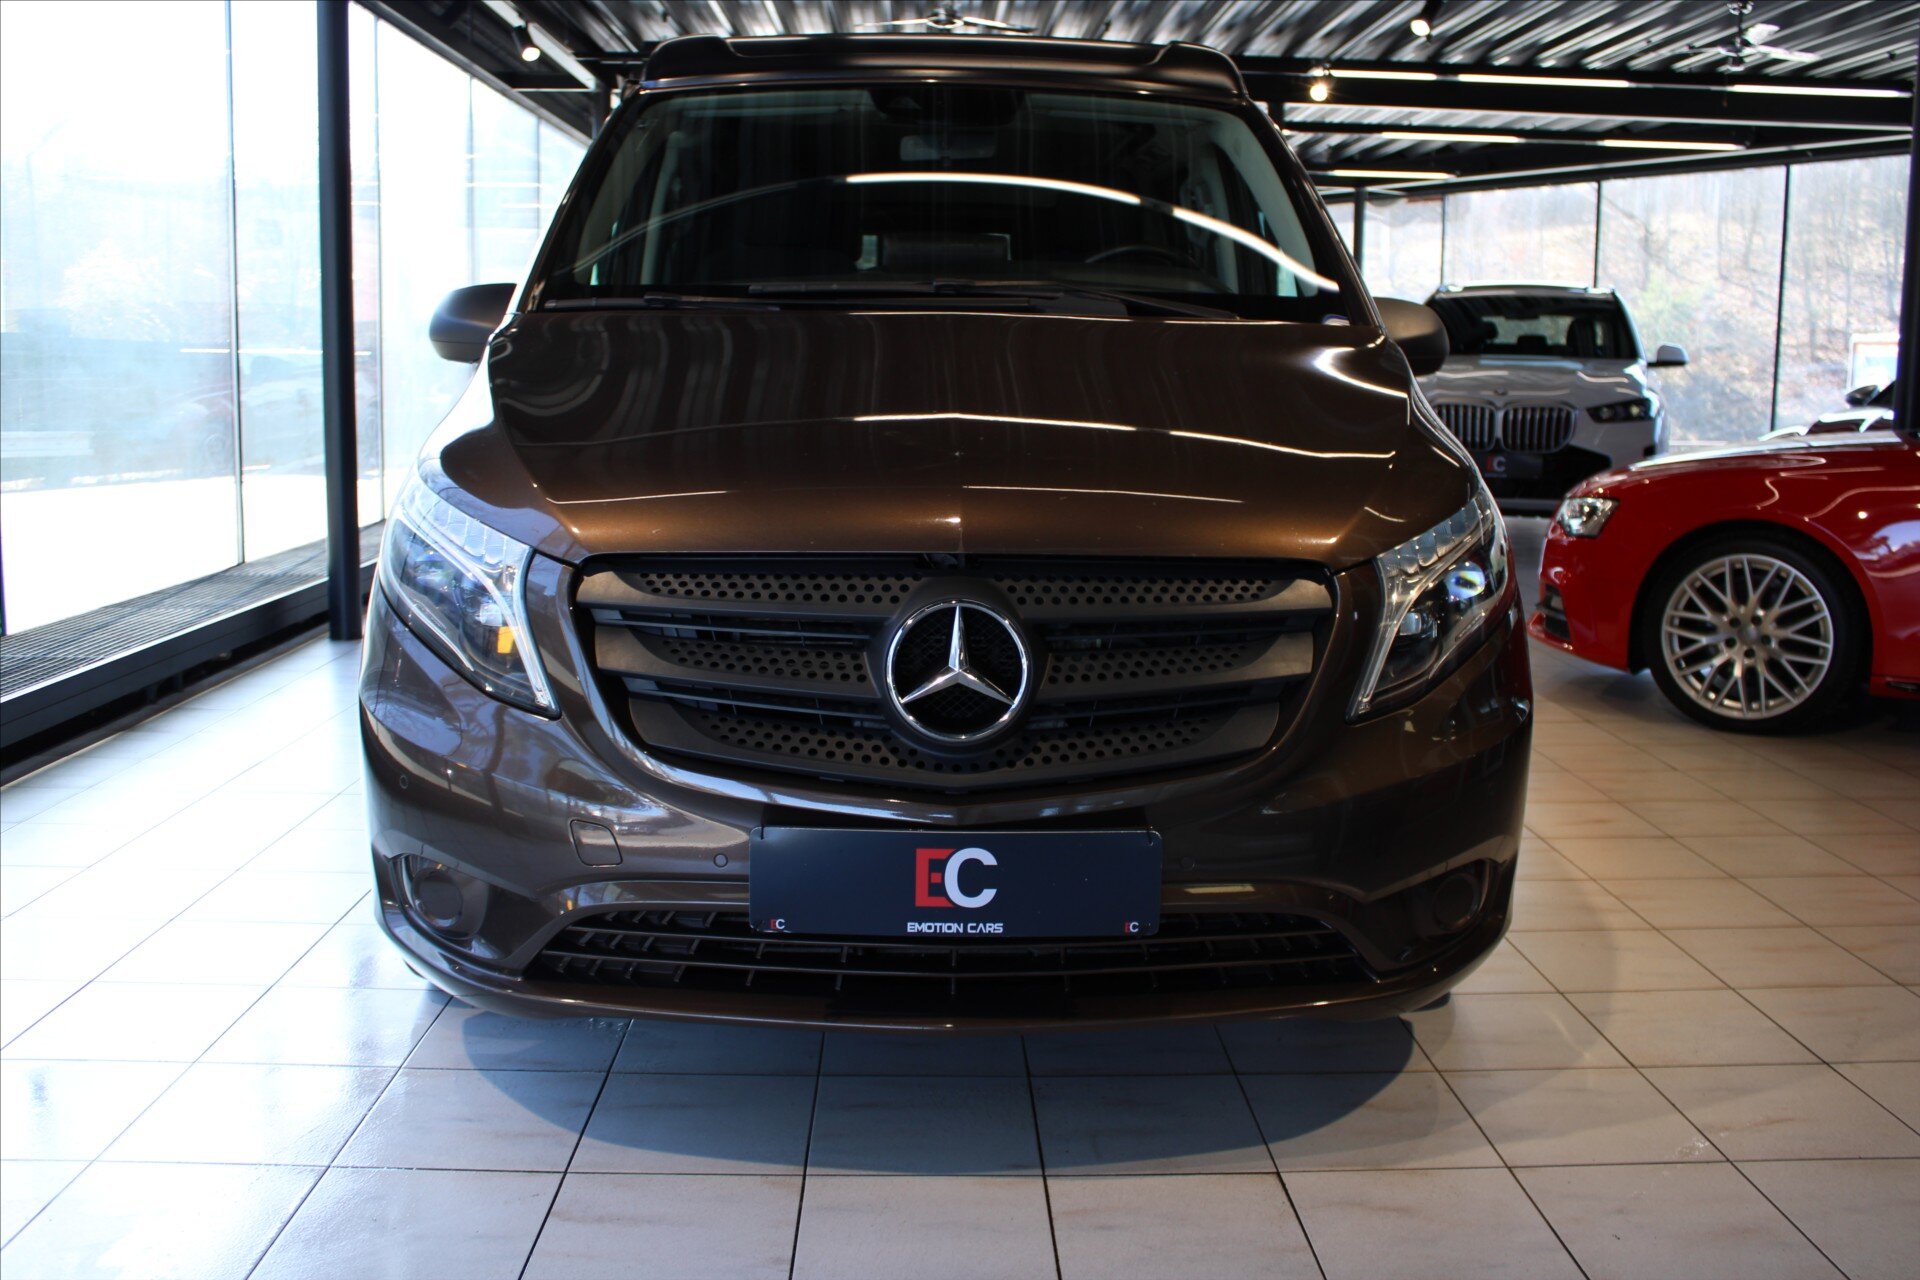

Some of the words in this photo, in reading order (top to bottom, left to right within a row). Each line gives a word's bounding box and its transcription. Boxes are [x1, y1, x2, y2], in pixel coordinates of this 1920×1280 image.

[915, 847, 998, 908] EC
[770, 918, 785, 930] EC
[907, 922, 963, 933] EMOTION
[967, 922, 1004, 933] CARS
